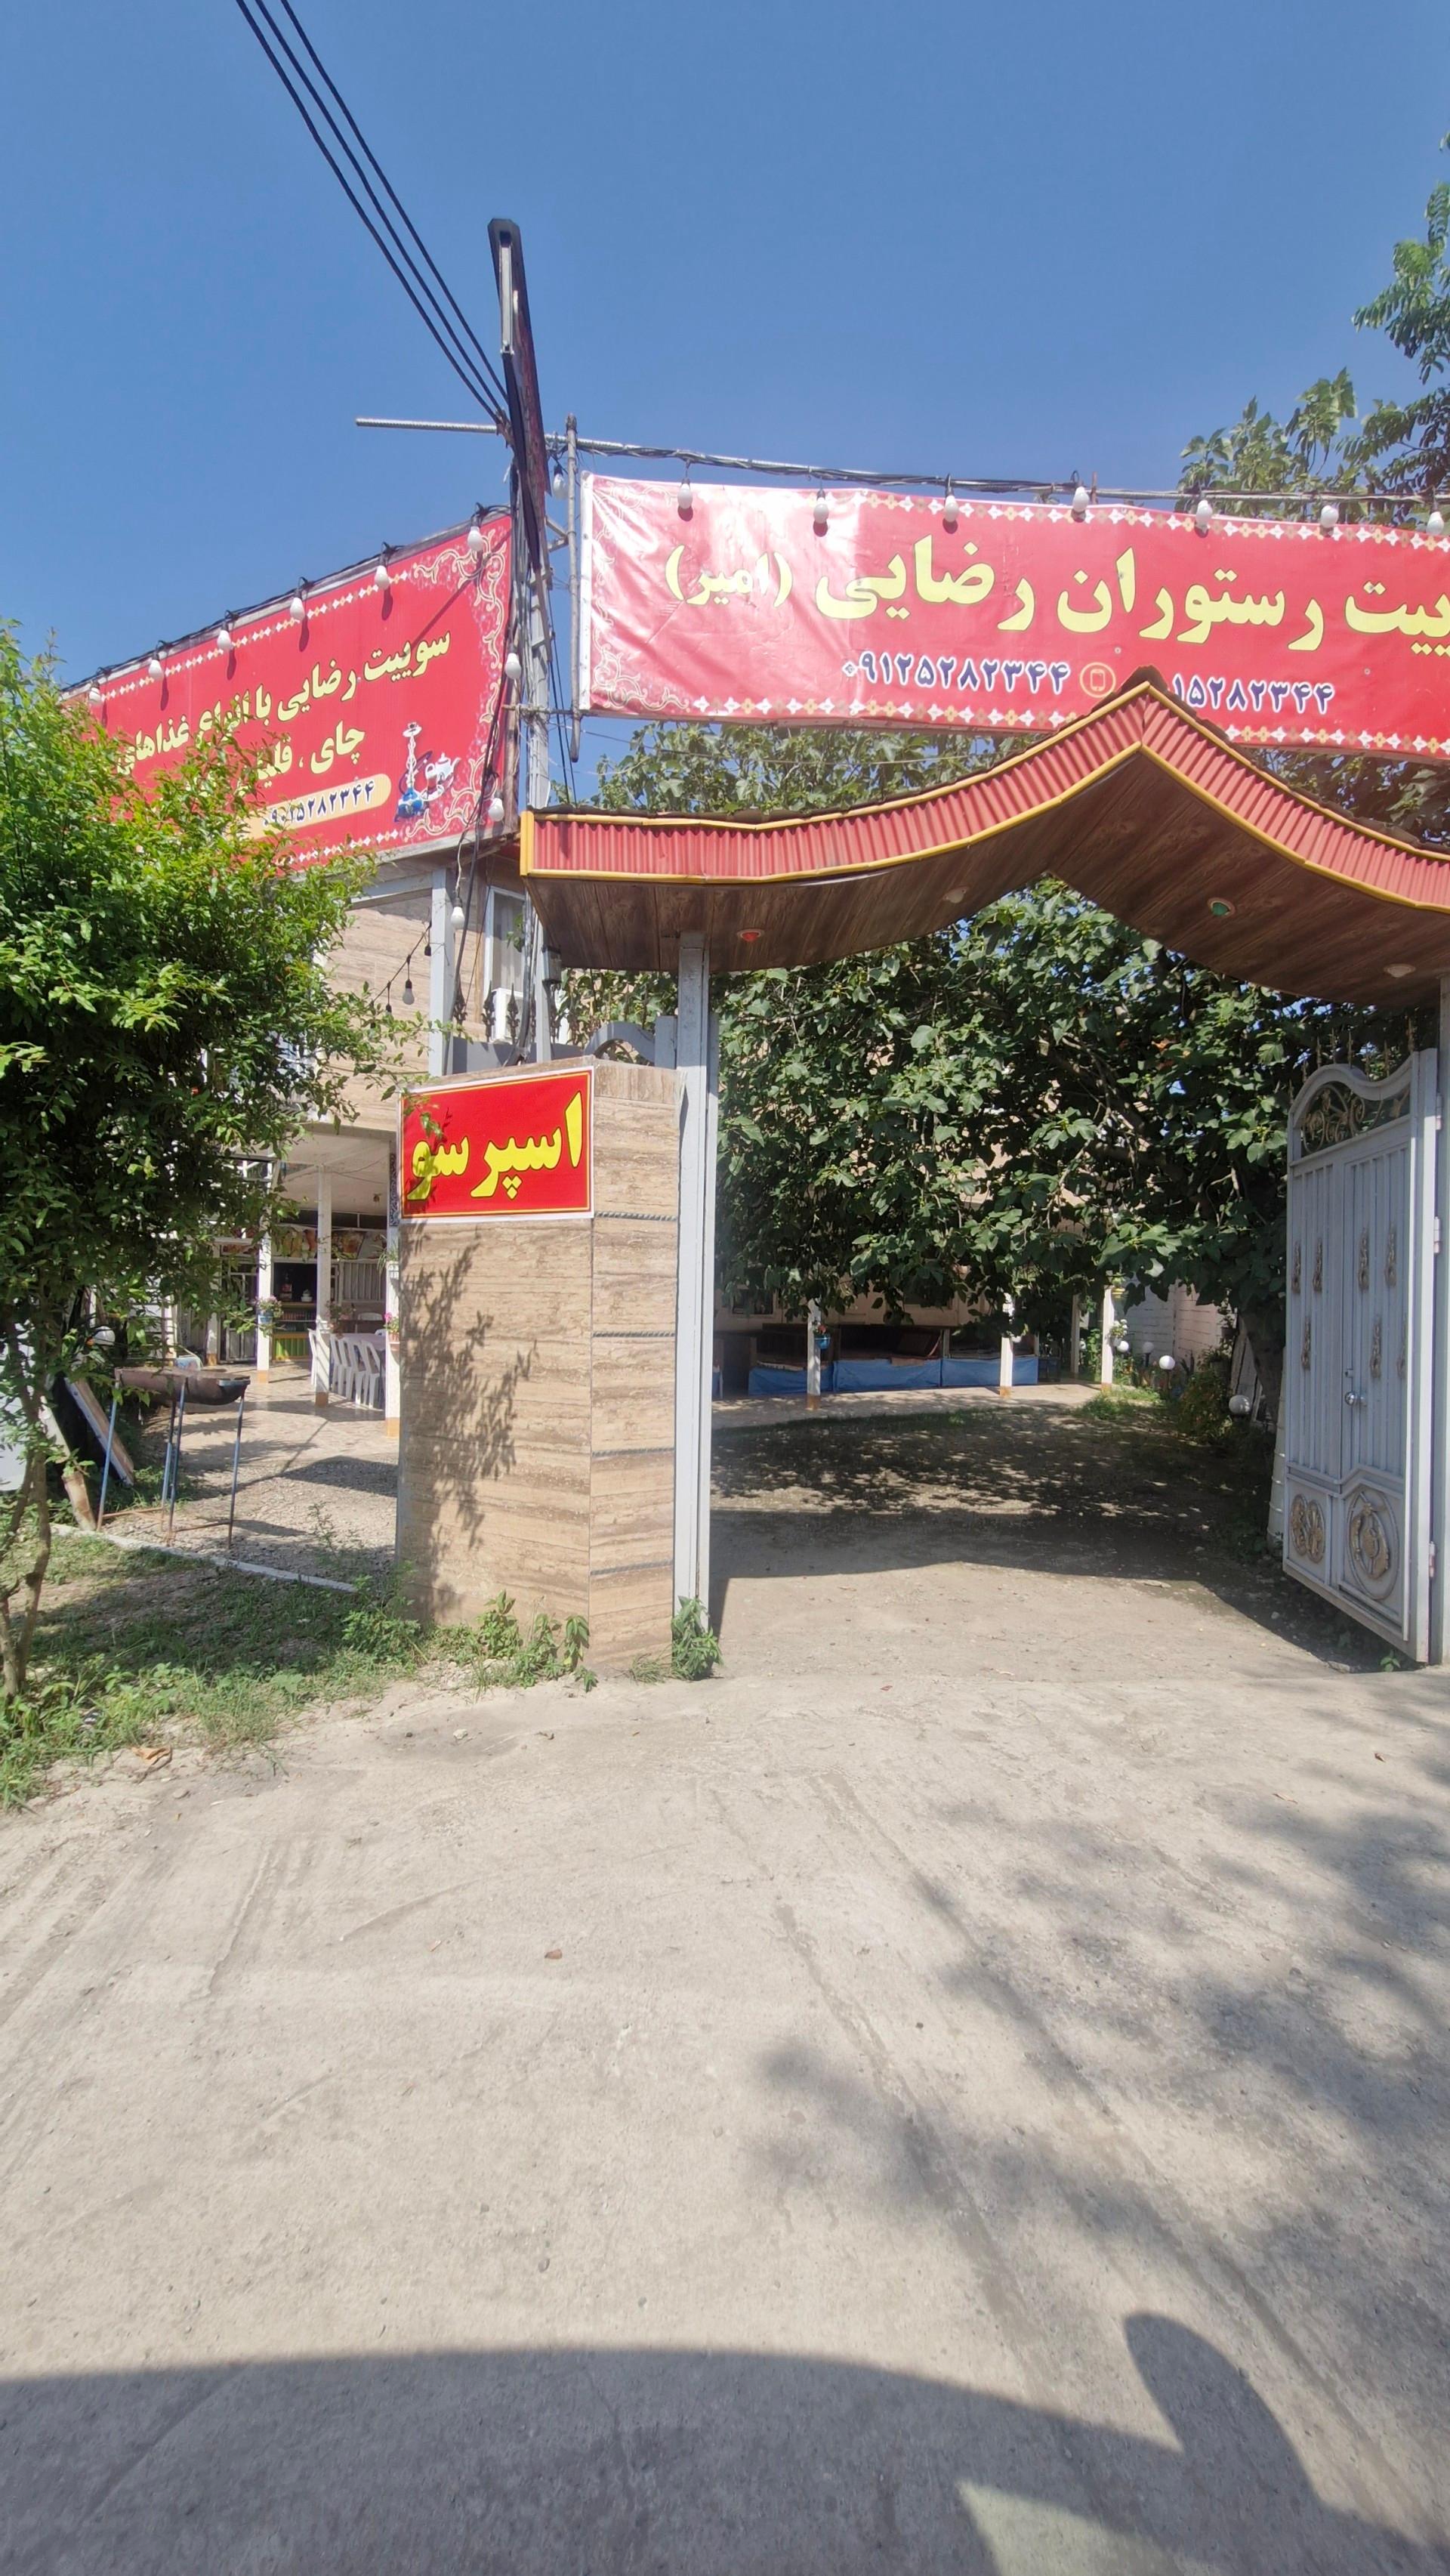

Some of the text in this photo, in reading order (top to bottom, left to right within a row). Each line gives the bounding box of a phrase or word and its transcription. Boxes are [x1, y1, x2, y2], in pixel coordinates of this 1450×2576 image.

[665, 544, 794, 607] (امیر)
[815, 534, 1035, 631] رضایی
[1057, 546, 1324, 651] رستوران
[363, 630, 451, 682] سوییت
[255, 683, 272, 726] با
[277, 659, 357, 721] رضایی
[1172, 673, 1334, 715] ۱۵۲۸۲۳۴۴
[310, 720, 366, 774] چای
[406, 1090, 583, 1200] اسپرسو
